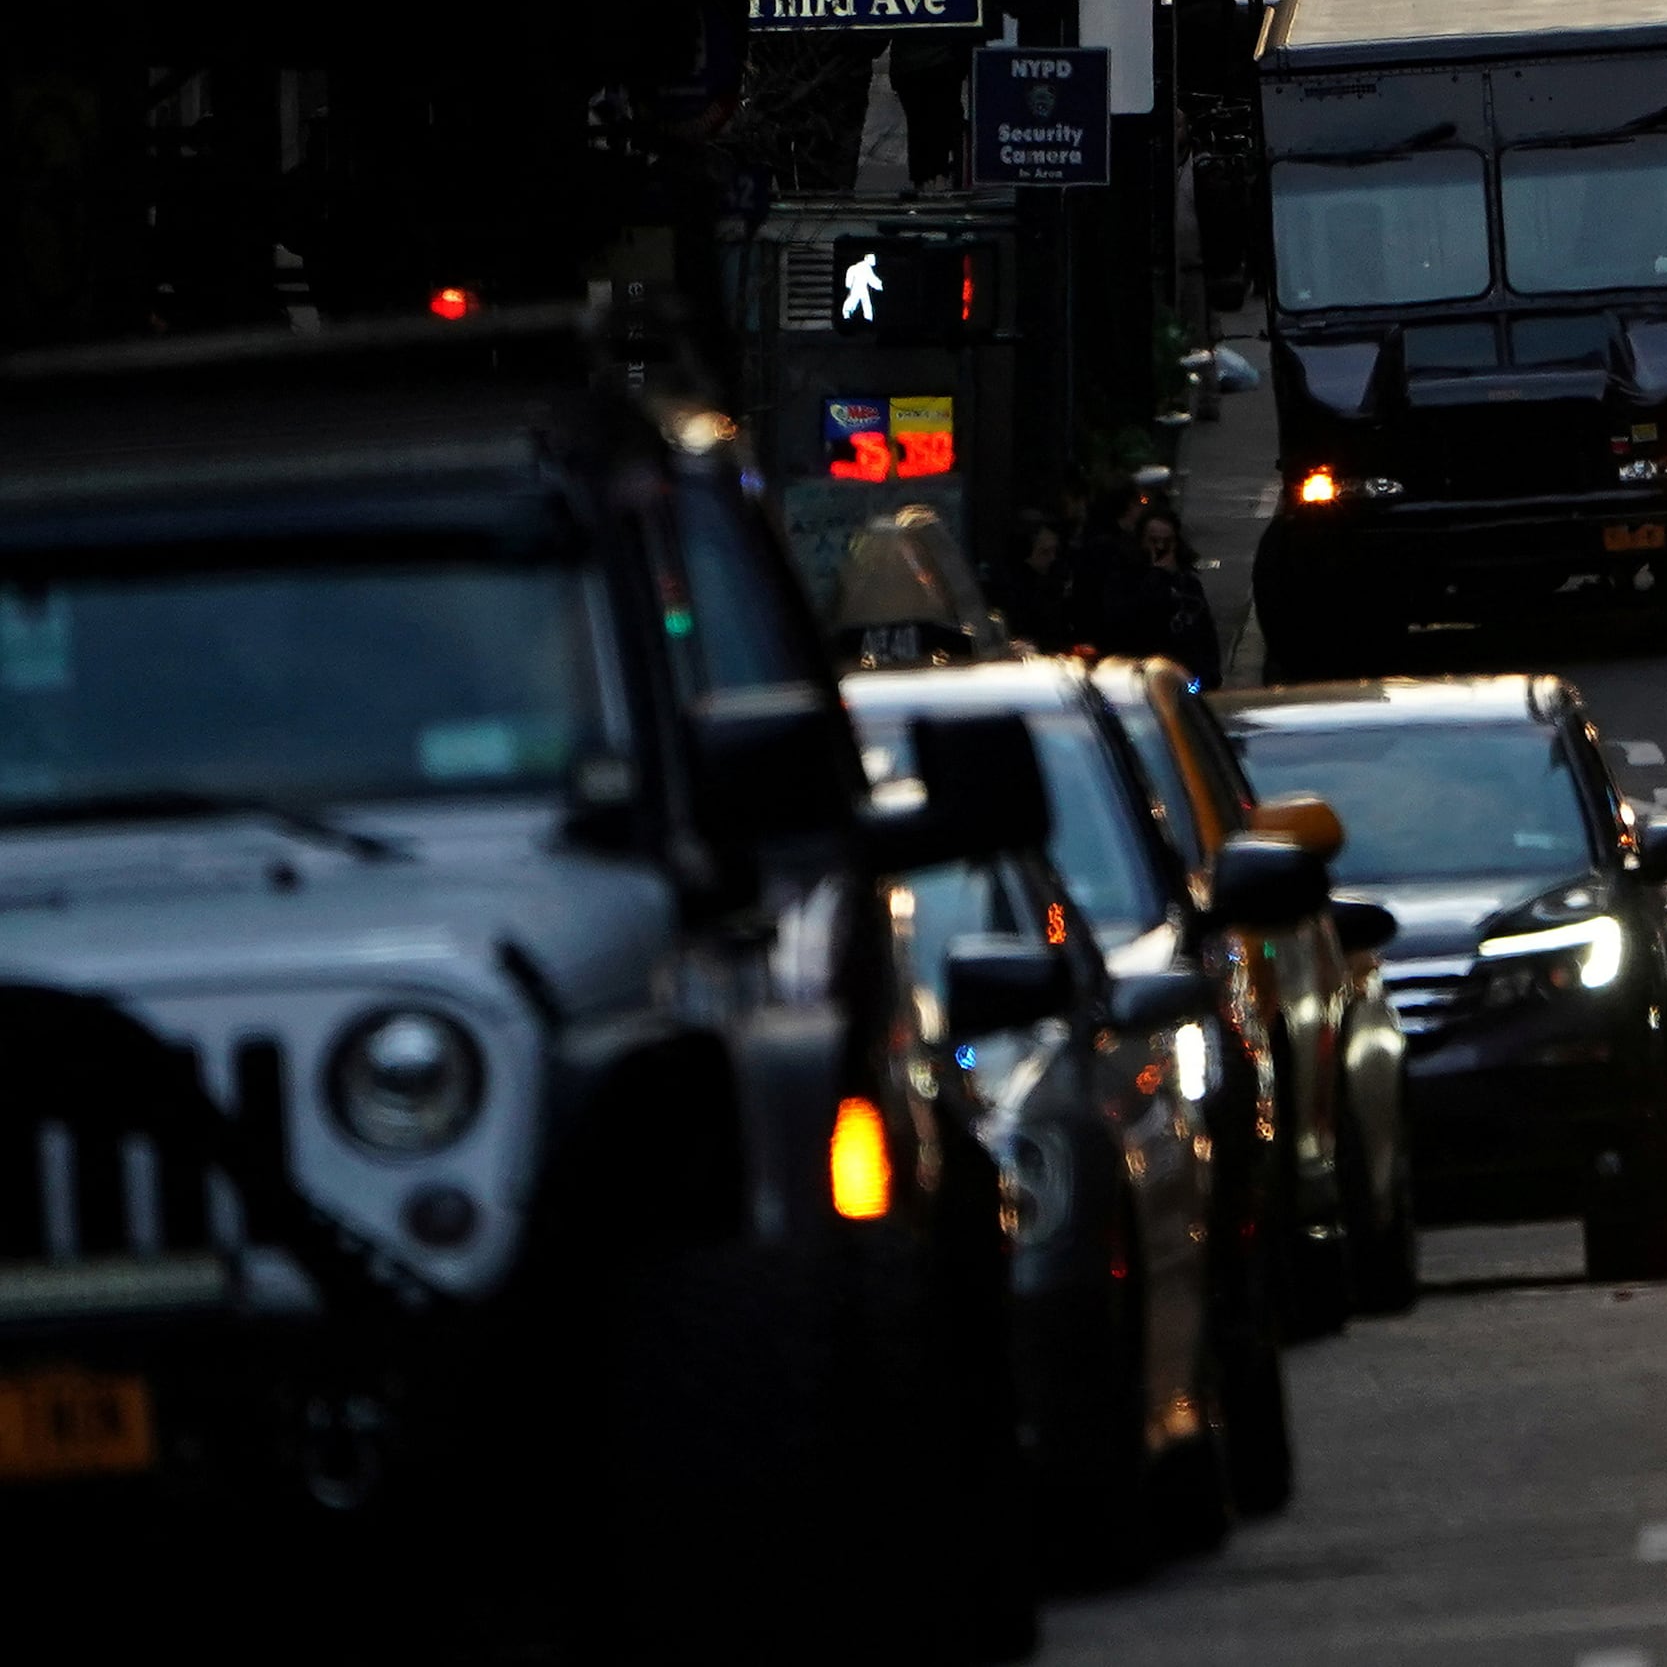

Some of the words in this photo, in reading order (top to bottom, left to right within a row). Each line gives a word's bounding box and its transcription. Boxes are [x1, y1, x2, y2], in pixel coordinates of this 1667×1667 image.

[1010, 58, 1073, 79] NYPD
[997, 123, 1083, 148] Security
[999, 145, 1083, 165] Camera
